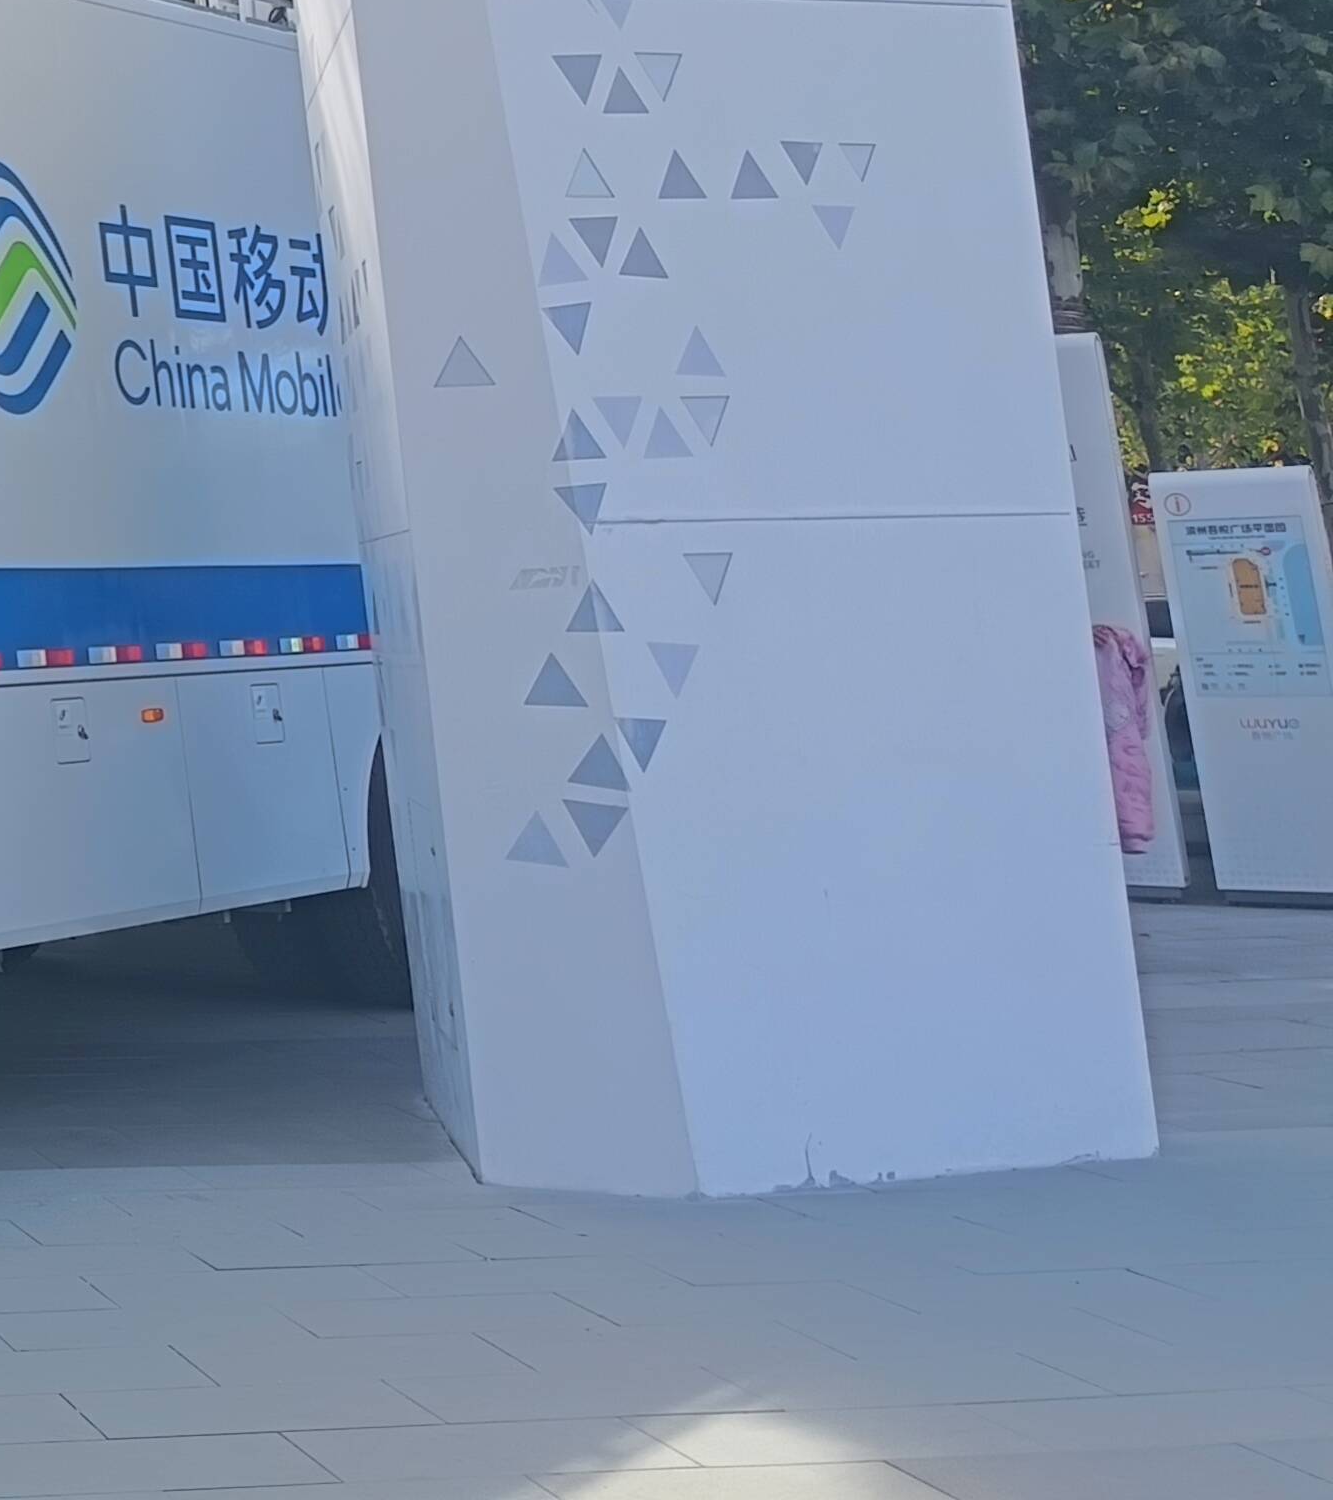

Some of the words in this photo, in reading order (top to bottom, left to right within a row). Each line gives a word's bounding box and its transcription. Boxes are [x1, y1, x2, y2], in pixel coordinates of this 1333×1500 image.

[99, 203, 329, 337] 中国移动
[115, 338, 232, 411] China
[238, 350, 343, 417] Mobil
